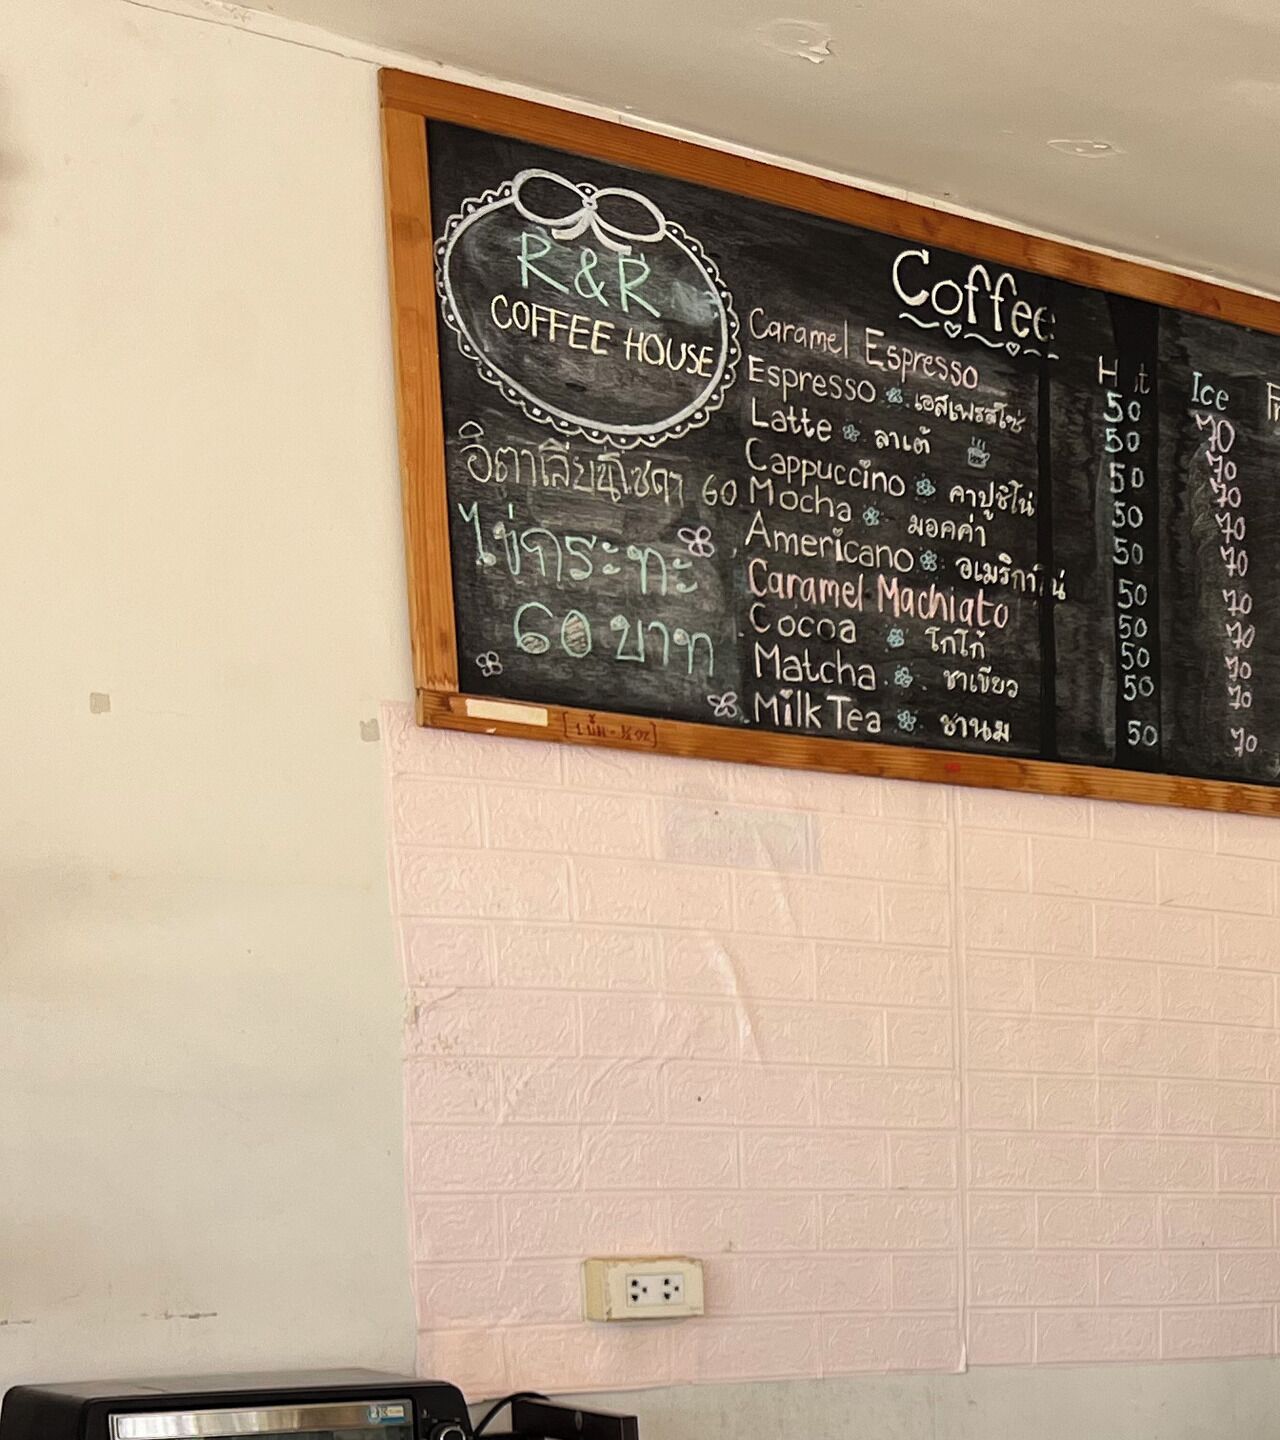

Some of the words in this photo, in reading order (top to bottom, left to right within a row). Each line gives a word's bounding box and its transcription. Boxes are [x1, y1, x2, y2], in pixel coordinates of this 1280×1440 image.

[517, 231, 660, 318] R&R
[892, 250, 1056, 342] Coffee
[491, 295, 614, 356] COFFEE
[623, 332, 714, 379] HOUSE
[750, 307, 850, 359] Caramel
[866, 328, 979, 390] Espresso
[747, 355, 876, 403] Espresso
[1191, 372, 1229, 411] Ice
[751, 397, 833, 443] Latte
[1103, 393, 1140, 422] 50
[1106, 429, 1140, 452] 50
[746, 437, 905, 498] Cappuccino
[1110, 464, 1144, 492] 50
[702, 474, 737, 506] 60
[750, 478, 852, 522] Mocha
[1112, 504, 1143, 530] 50
[744, 519, 914, 573] Americano
[1113, 539, 1143, 565] 50
[748, 559, 863, 613] Caramel
[877, 579, 1009, 629] Machiato
[1118, 581, 1146, 608] 50
[513, 601, 592, 658] 60
[610, 613, 714, 677] บาท
[749, 598, 856, 644] Cocoa
[924, 626, 986, 660] โกโก้
[1118, 616, 1147, 640] 50
[755, 641, 876, 690] Matcha
[1121, 646, 1149, 668] 50
[1123, 675, 1154, 701] 50
[754, 690, 821, 730] Milk
[826, 694, 882, 733] Tea
[1128, 721, 1158, 746] 50
